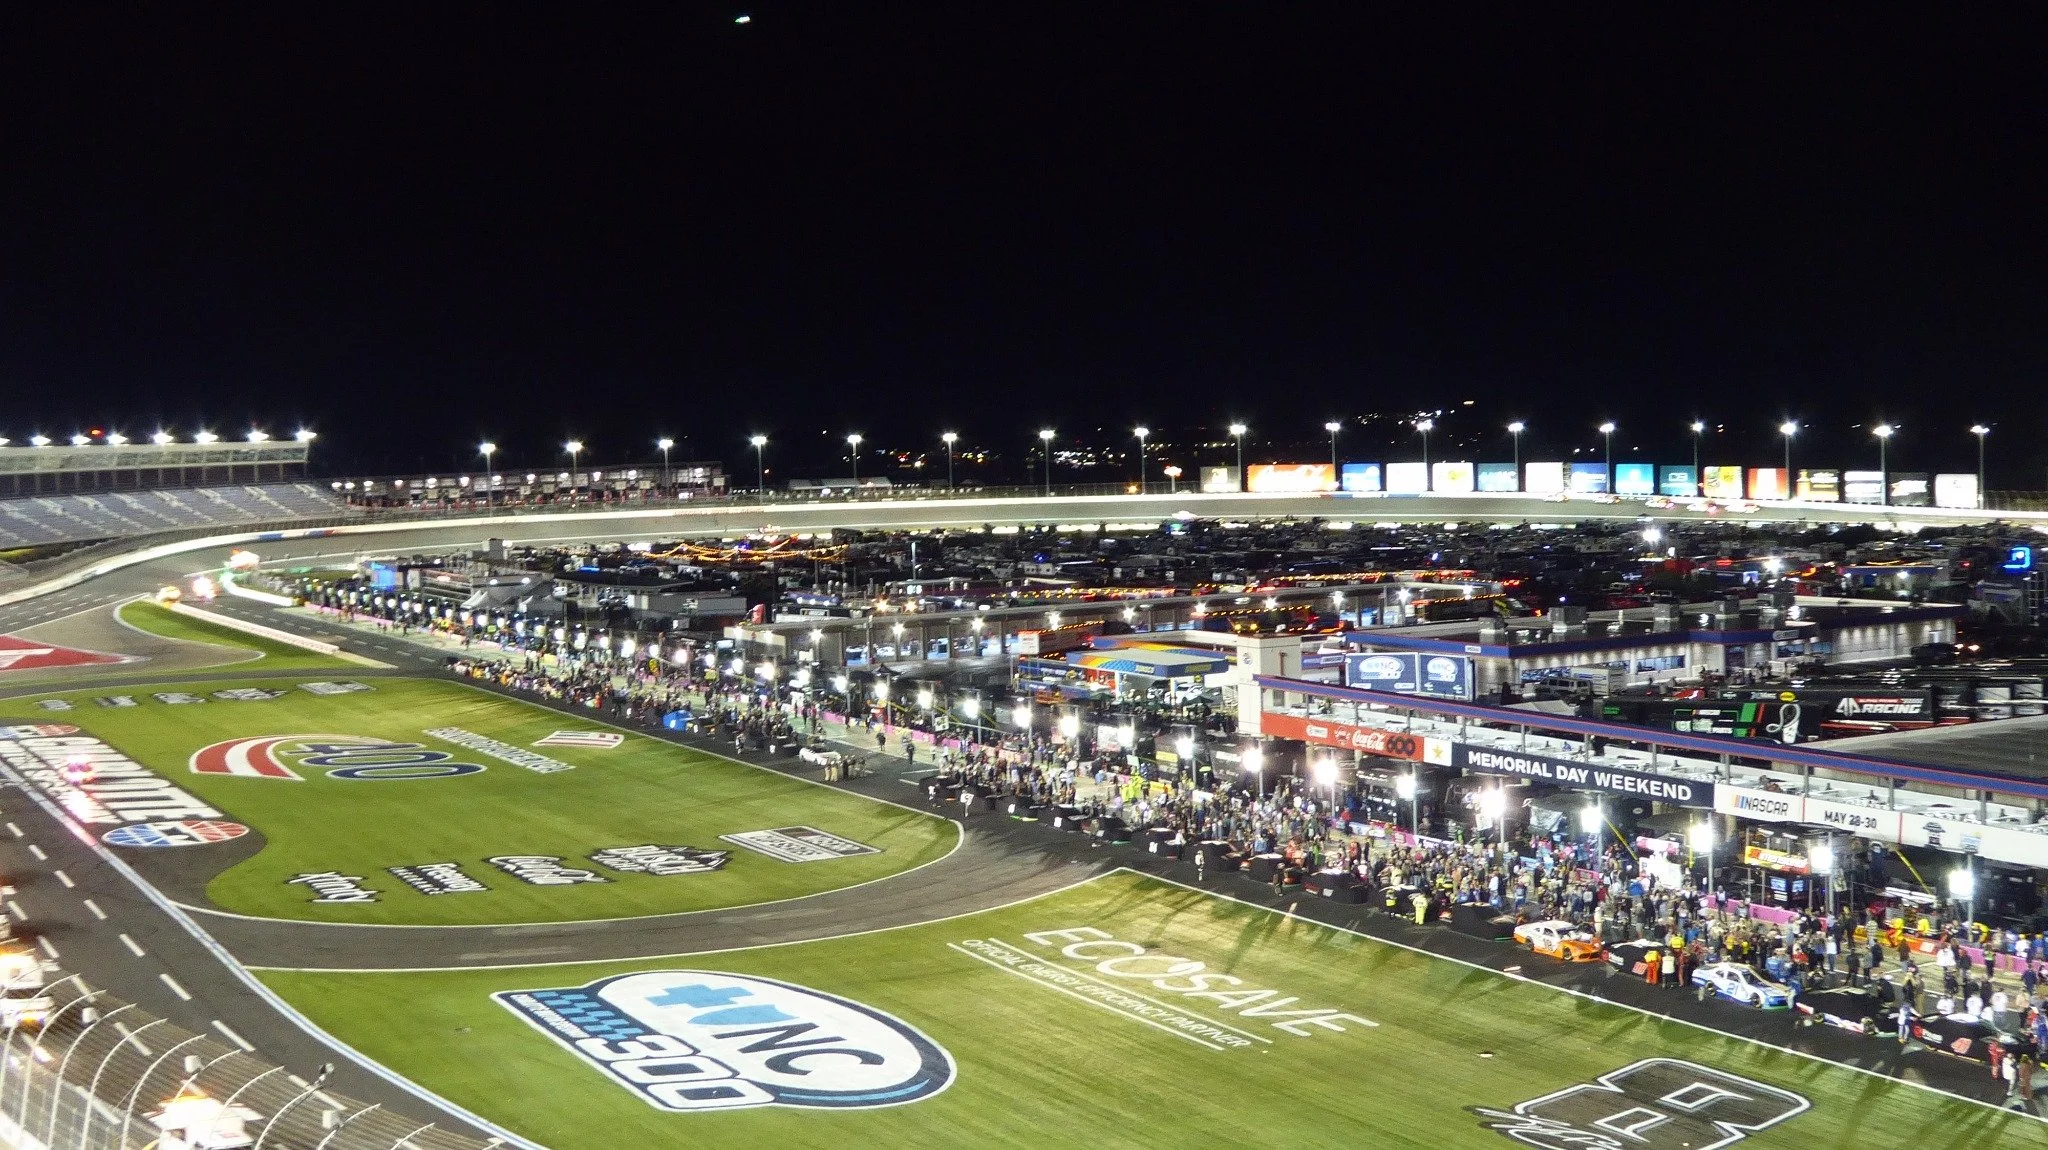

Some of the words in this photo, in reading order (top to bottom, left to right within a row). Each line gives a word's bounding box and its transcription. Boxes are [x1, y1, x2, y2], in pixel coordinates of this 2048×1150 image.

[1862, 704, 1922, 714] RACING
[1468, 751, 1552, 777] MEMORIAL
[1556, 766, 1589, 784] DAY
[1594, 771, 1692, 801] WEEKEND
[1745, 797, 1789, 816] NASCAR
[1824, 809, 1847, 824] MAY
[1849, 814, 1877, 829] 28-30
[962, 938, 1026, 967] OFFICIAL
[1017, 962, 1084, 991] ENERGY
[1076, 984, 1176, 1019] EFFICIENCY
[1158, 1013, 1252, 1048] PARTNER
[1022, 926, 1380, 1038] ECOSAVE
[575, 1034, 775, 1109] 300
[712, 1021, 885, 1077] NC
